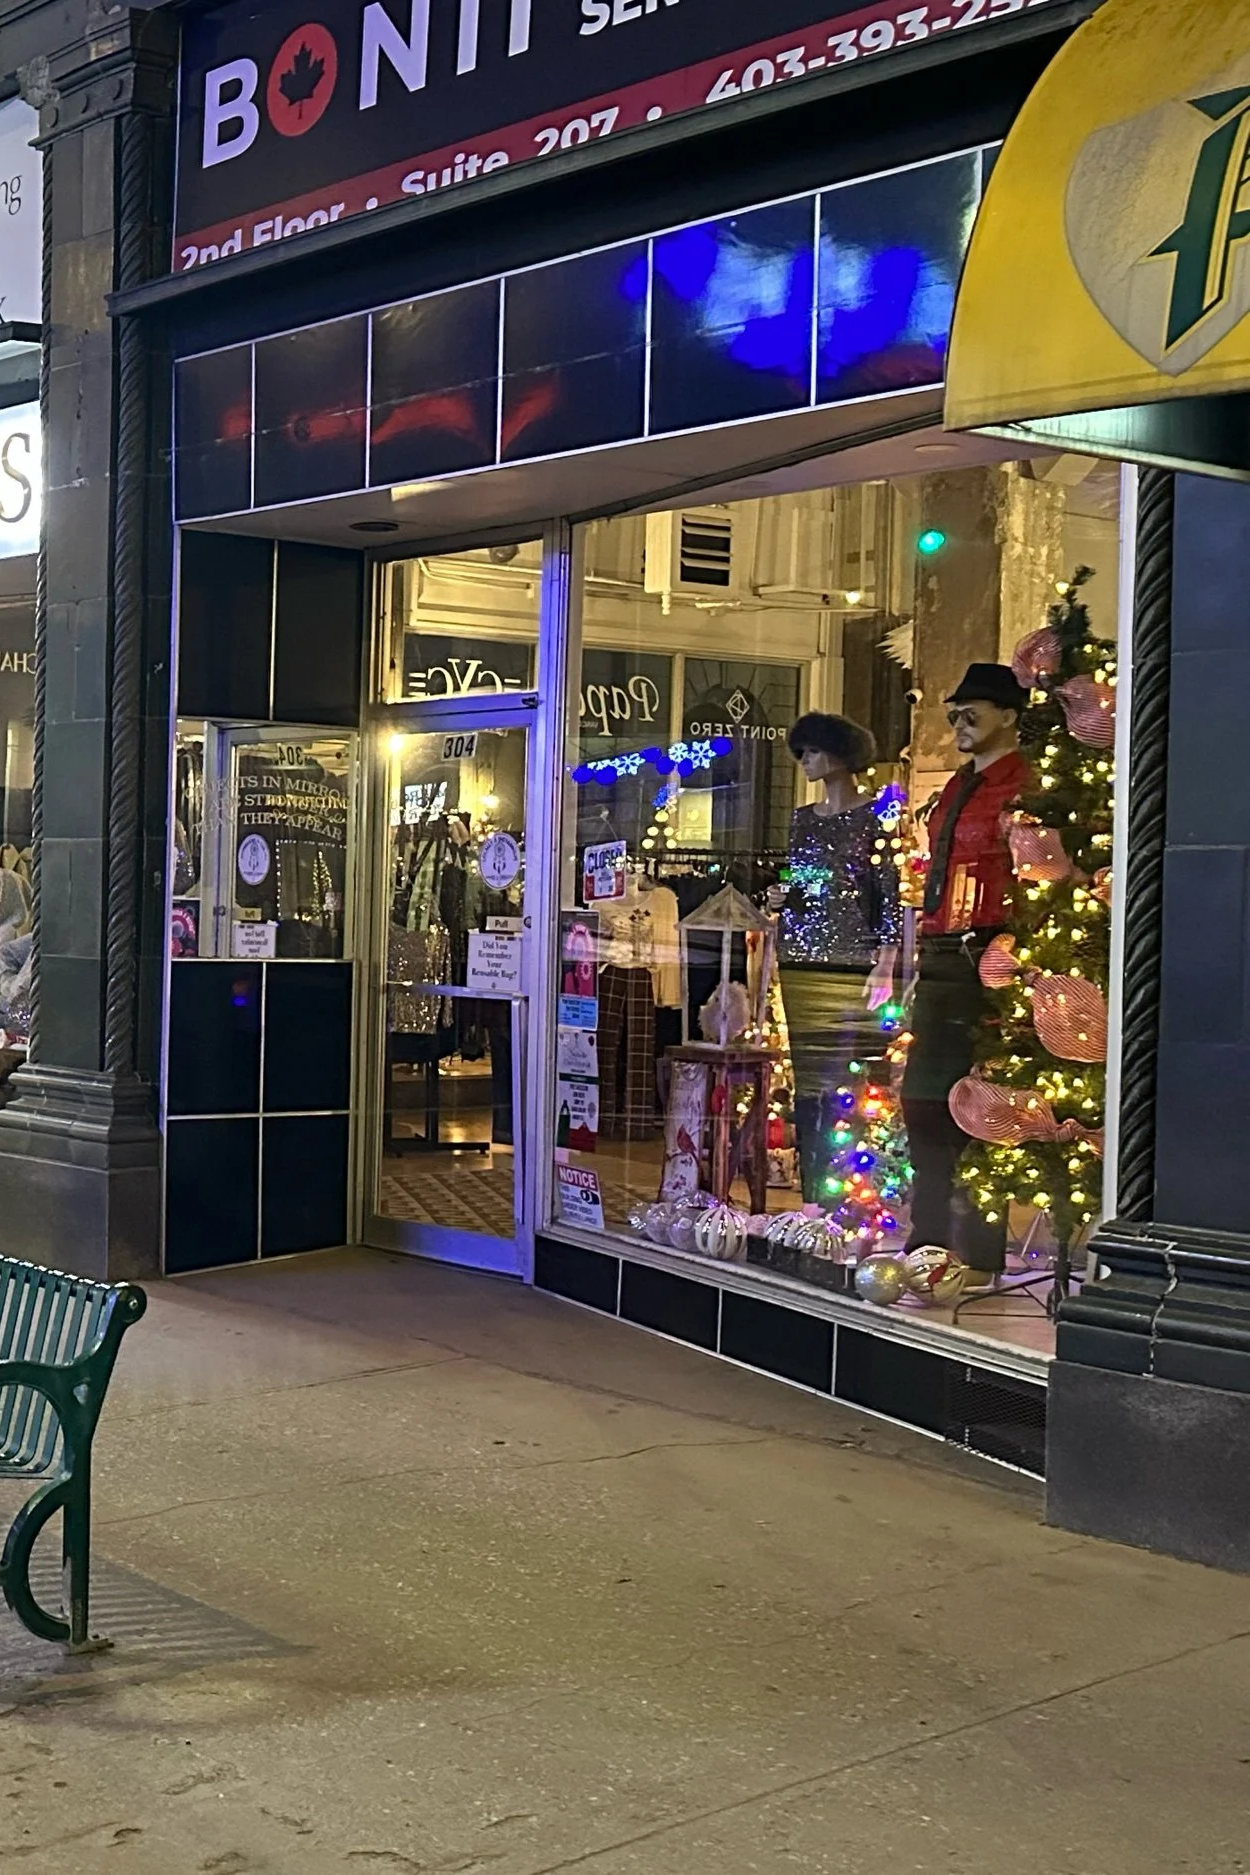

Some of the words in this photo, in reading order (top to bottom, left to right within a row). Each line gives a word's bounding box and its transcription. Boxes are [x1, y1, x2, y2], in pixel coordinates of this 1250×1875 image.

[180, 228, 243, 270] 2nd
[253, 201, 346, 247] Floor
[401, 150, 510, 195] Suite
[534, 106, 620, 157] 207
[443, 735, 476, 759] 304
[262, 776, 282, 789] IN
[286, 777, 348, 801] MIRRO
[240, 812, 281, 825] THEY
[285, 815, 343, 841] APPEAR
[494, 919, 509, 929] Pull
[559, 1166, 596, 1189] NOTICE
